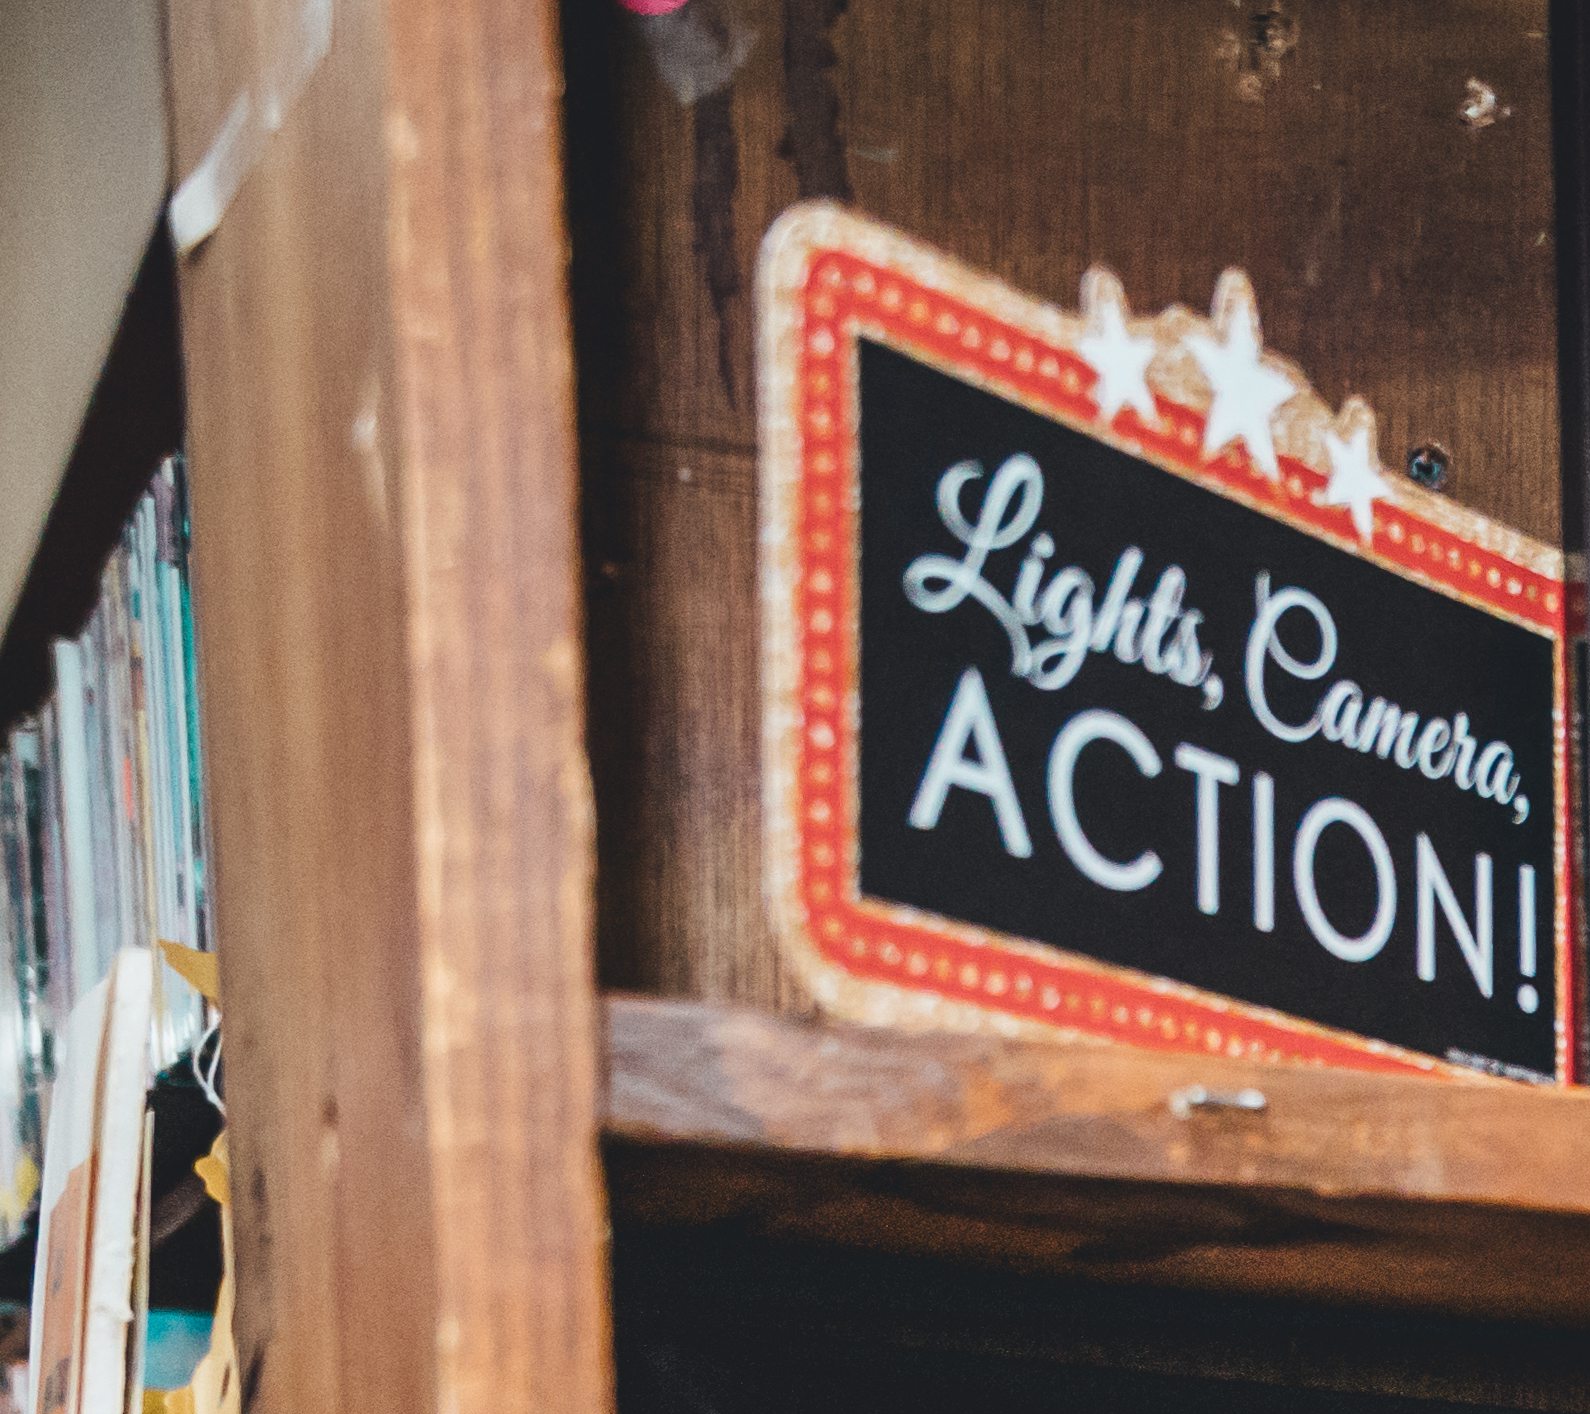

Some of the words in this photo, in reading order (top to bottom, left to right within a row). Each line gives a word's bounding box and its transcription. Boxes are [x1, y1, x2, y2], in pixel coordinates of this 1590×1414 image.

[903, 453, 1224, 711] Lights,
[1244, 571, 1531, 826] Camera,
[909, 667, 1540, 1015] ACTION!
